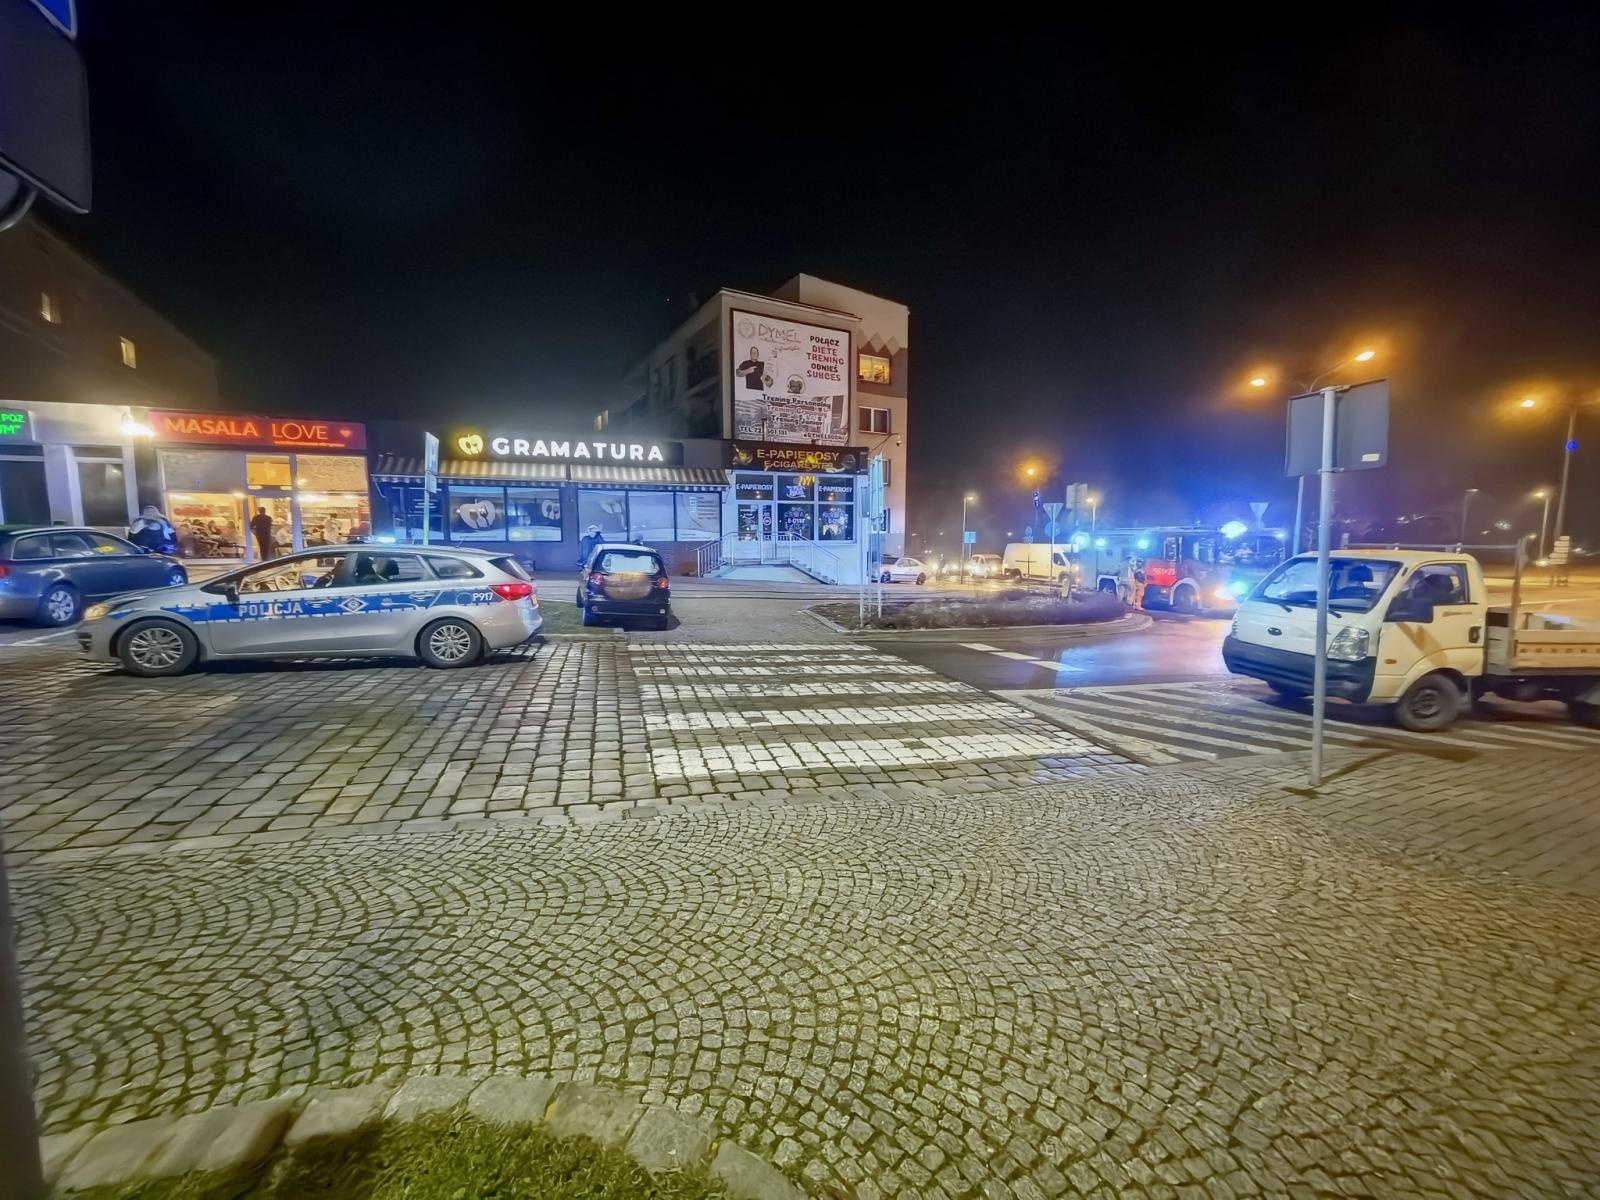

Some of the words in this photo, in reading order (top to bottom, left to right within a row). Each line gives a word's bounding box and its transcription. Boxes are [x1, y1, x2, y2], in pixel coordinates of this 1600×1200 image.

[806, 352, 844, 365] TRENING
[164, 417, 259, 437] MASALA
[271, 422, 329, 440] LOVE
[491, 437, 664, 462] GRAMATURA
[756, 449, 840, 461] E-PAPIEROSY
[472, 592, 494, 602] P917
[239, 602, 304, 617] POLICJA
